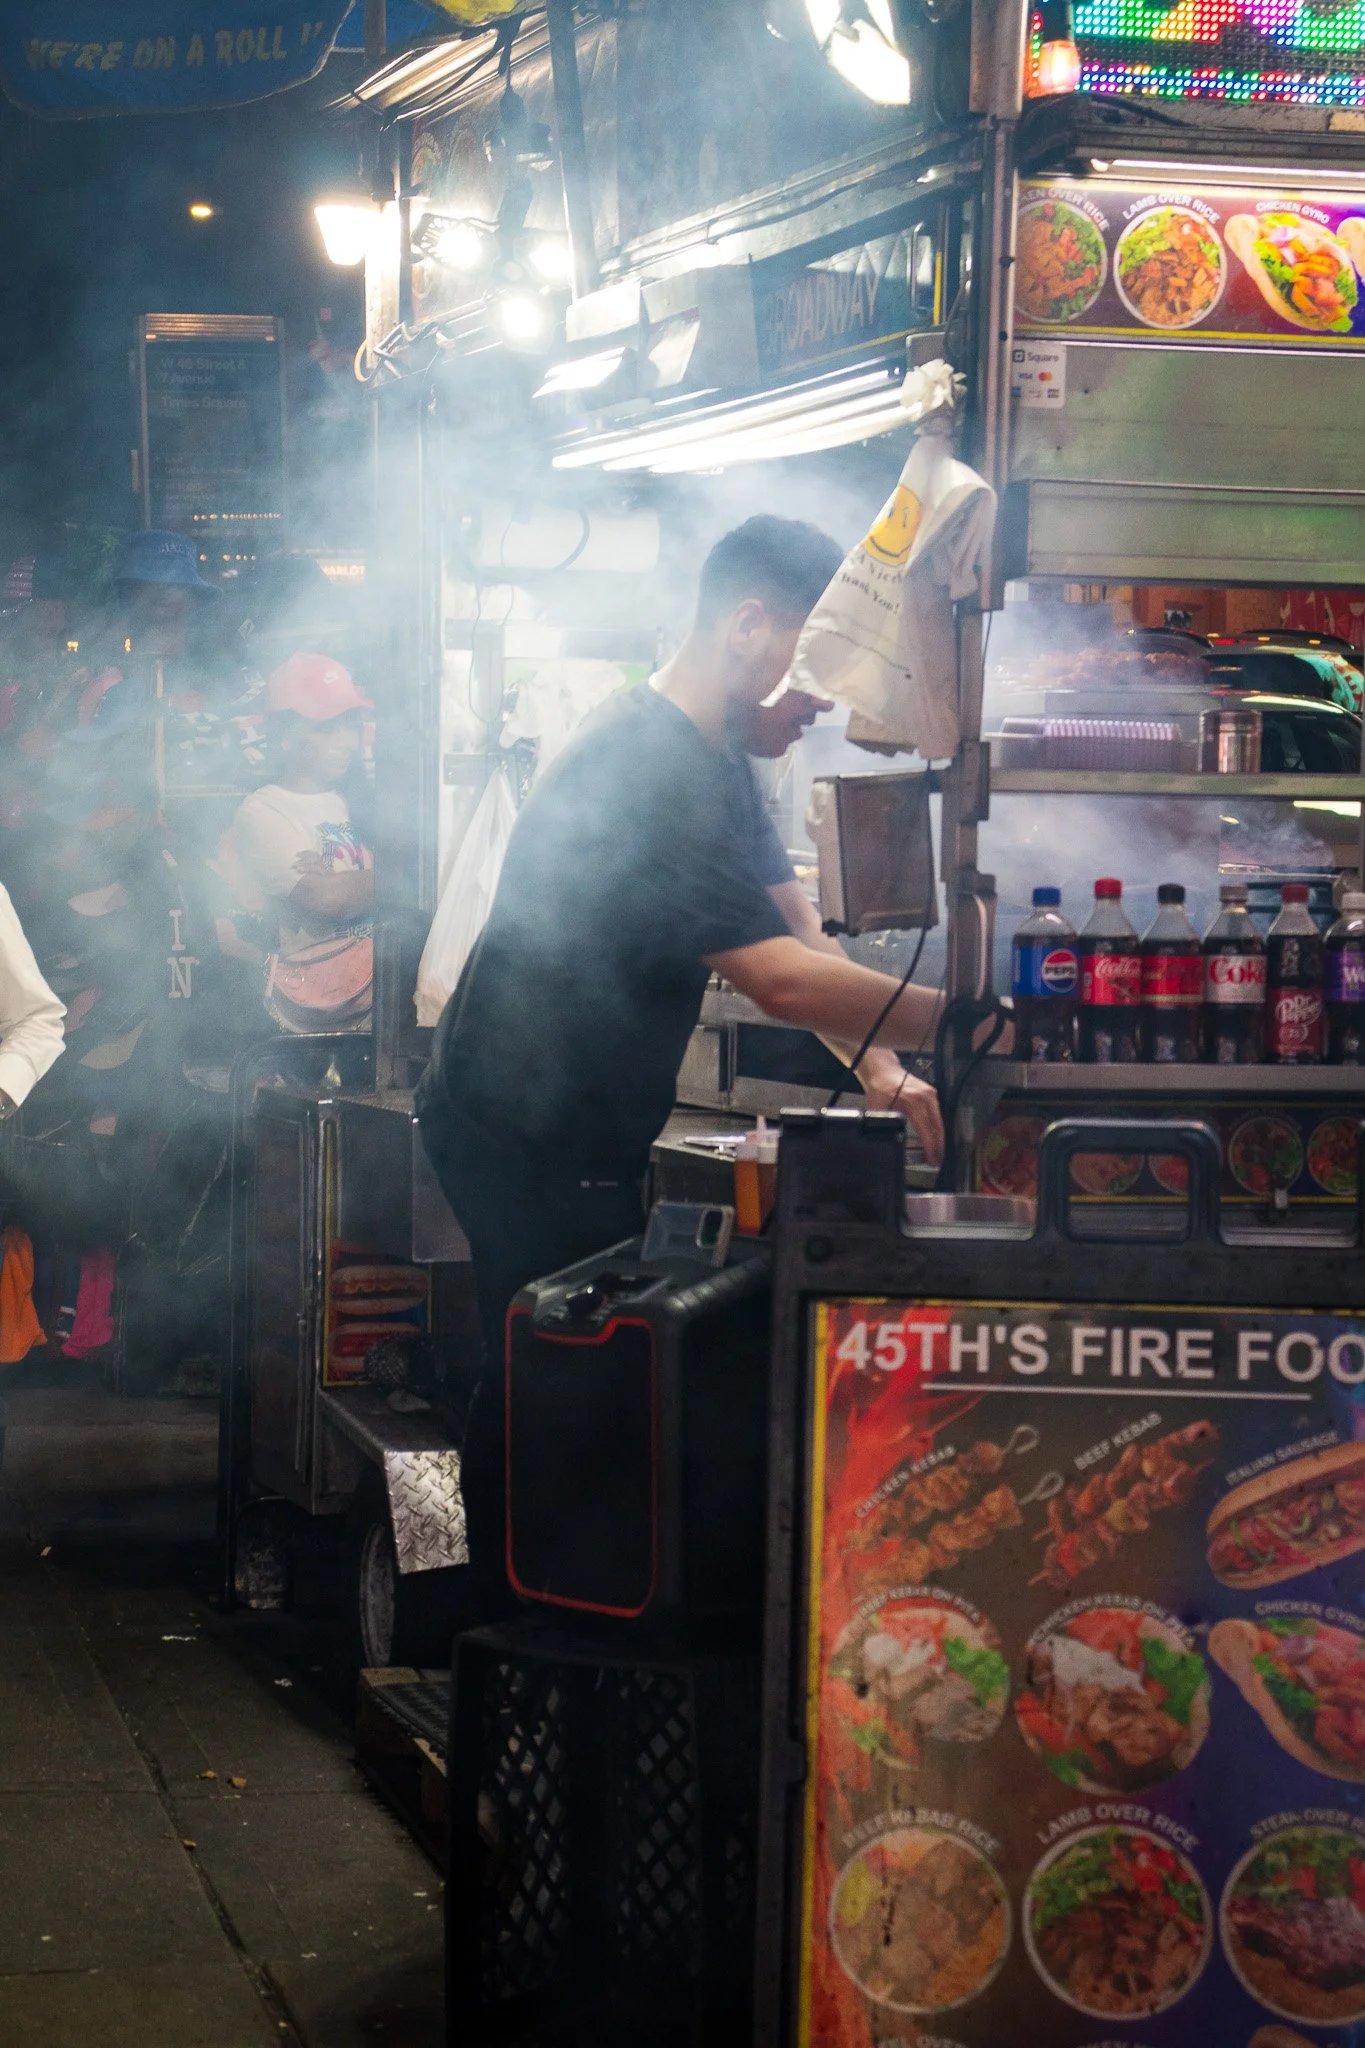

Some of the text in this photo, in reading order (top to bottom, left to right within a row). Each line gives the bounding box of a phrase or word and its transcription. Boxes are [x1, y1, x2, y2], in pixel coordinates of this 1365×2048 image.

[27, 37, 124, 71] WE'RE
[132, 36, 175, 68] ON
[186, 34, 204, 66] A
[215, 25, 288, 66] ROLL
[1048, 187, 1083, 205] OVER
[1083, 201, 1110, 231] RICE
[1122, 194, 1220, 224] LAMB OVER RICE
[1256, 201, 1330, 224] CHICKEN GYRO
[1028, 352, 1059, 362] Square
[1045, 966, 1076, 976] PEPS
[836, 1322, 1365, 1384] 45TH'S FIRE FOO
[1074, 1411, 1161, 1470] BEEF KEBAB
[1225, 1429, 1339, 1486] ITALIAN SAUSAGE
[855, 1444, 957, 1518] CHICKEN KEBAB
[931, 1586, 953, 1601] ON
[1255, 1600, 1323, 1616] CHICKEN
[1027, 1597, 1094, 1648] CHICKEN
[1142, 1600, 1166, 1619] ON
[957, 1818, 1001, 1853] RICE
[1036, 1803, 1199, 1852] LAMB OVER RICE
[1250, 1808, 1350, 1839] STEAK OVER
